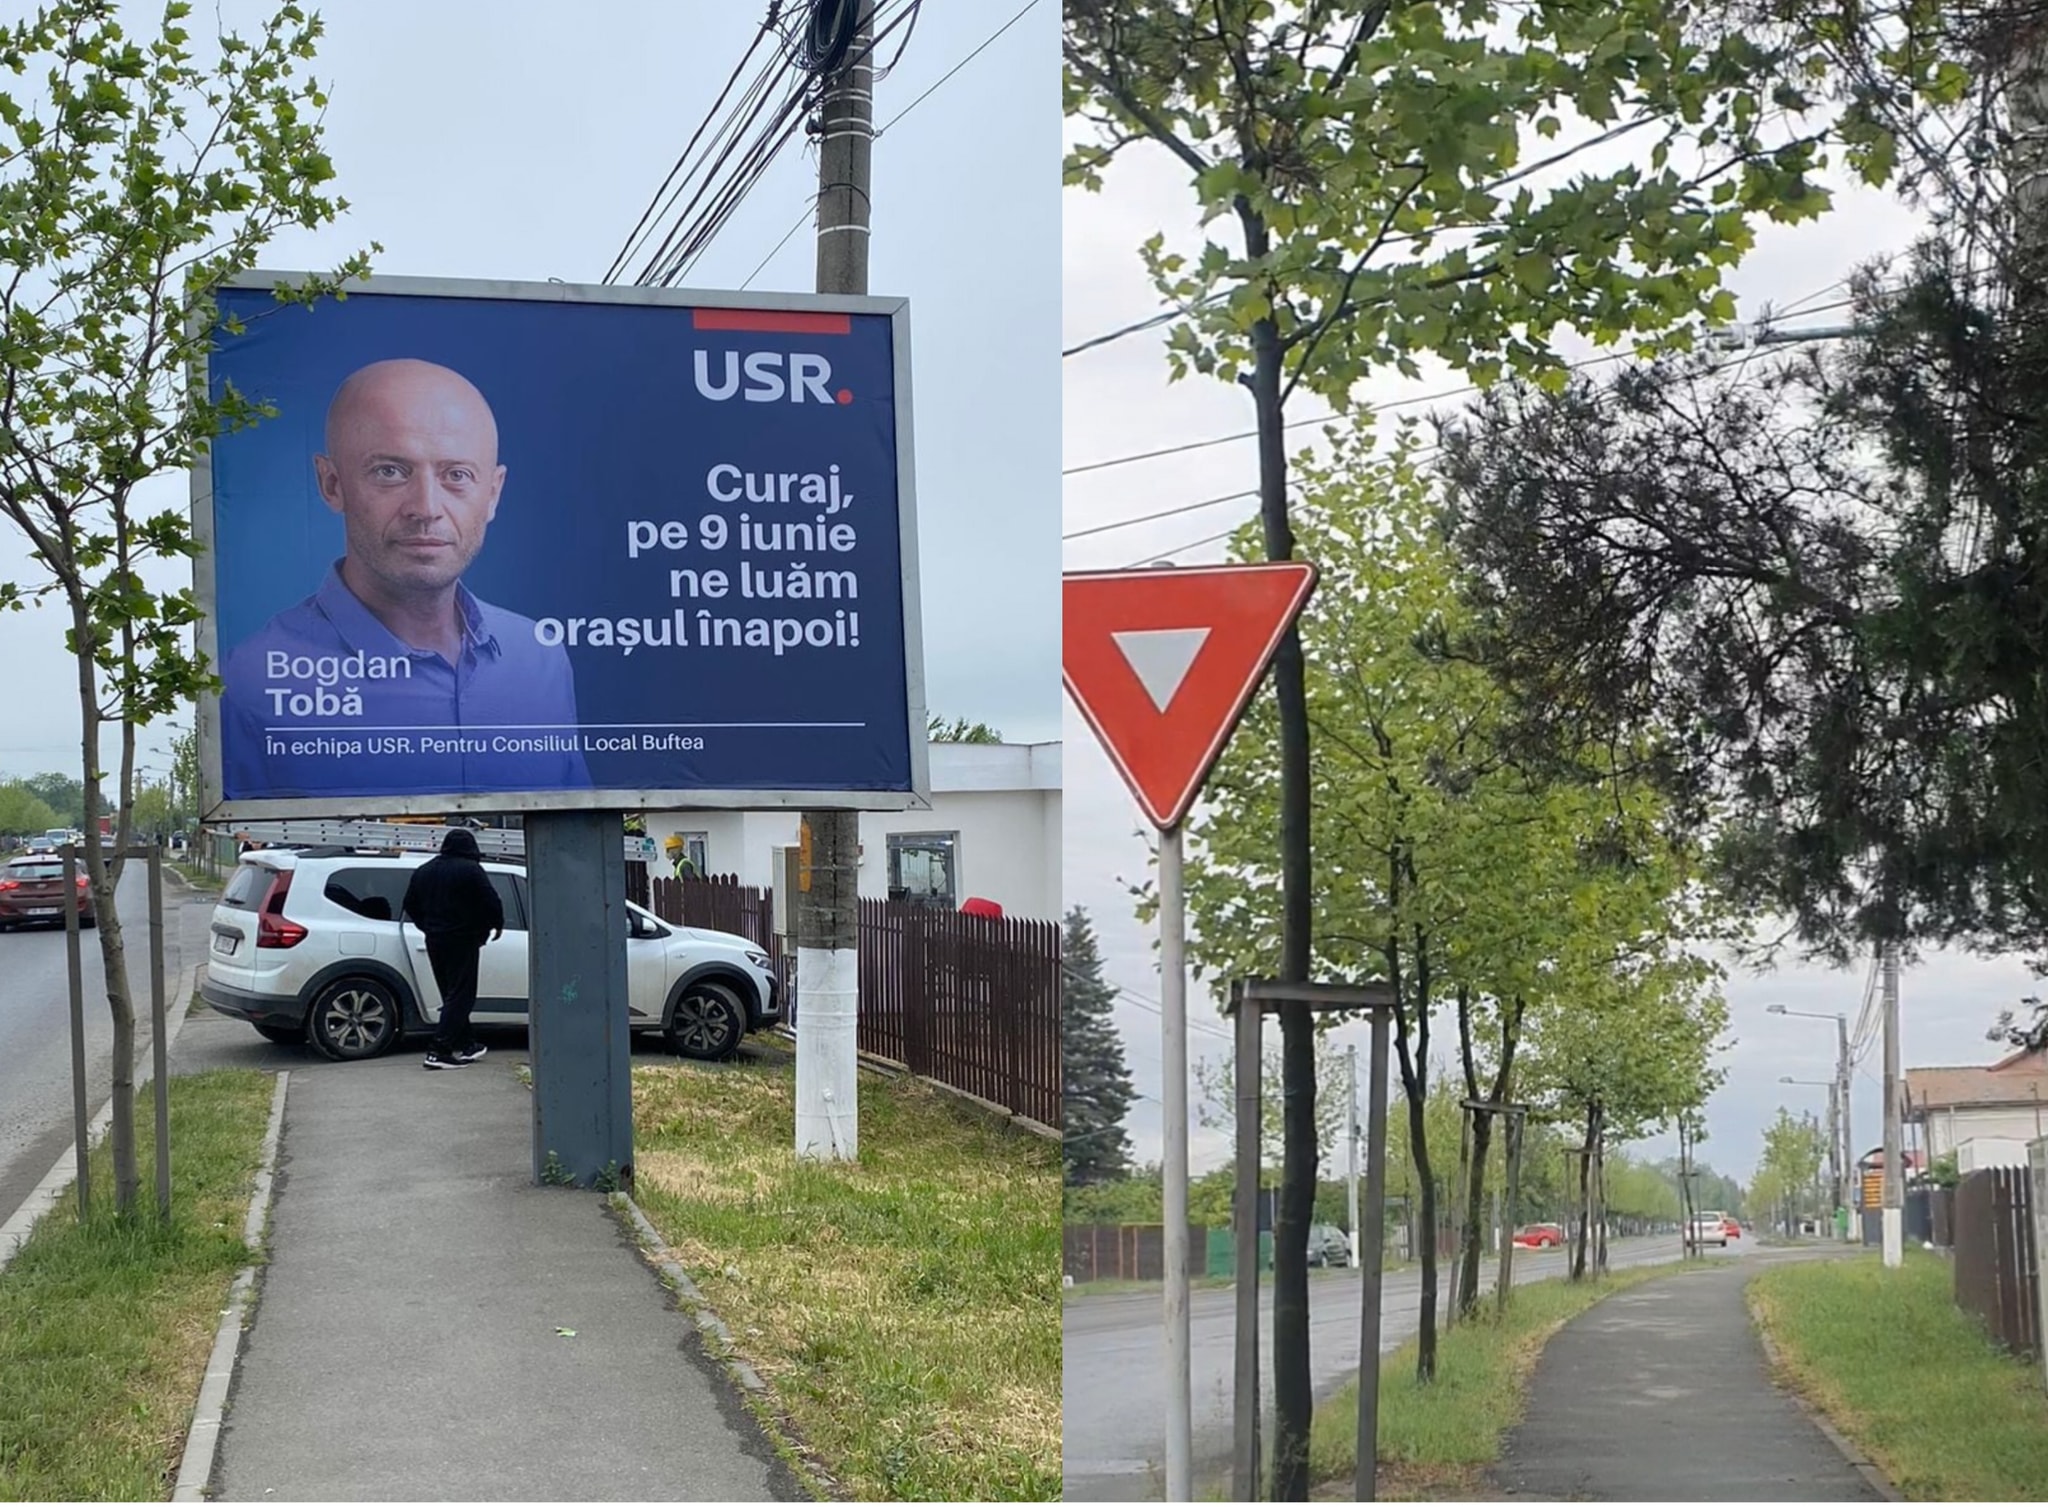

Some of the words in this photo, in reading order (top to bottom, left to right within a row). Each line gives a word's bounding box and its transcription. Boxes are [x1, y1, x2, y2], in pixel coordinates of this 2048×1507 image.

[706, 463, 854, 514] Curaj,
[627, 520, 688, 558] pe
[699, 513, 728, 551] 9
[740, 512, 857, 552] iunie
[670, 569, 729, 598] ne
[740, 561, 858, 599] luăm
[533, 608, 689, 657] orașul
[696, 609, 861, 656] înapoi!
[266, 649, 412, 687] Bogdan
[264, 686, 364, 717] Tobă
[265, 735, 286, 755] În
[290, 738, 362, 758] echipa
[367, 737, 415, 754] USR.
[421, 737, 487, 753] Pentru
[492, 735, 579, 752] Consiliul
[584, 734, 637, 751] Local
[642, 733, 704, 750] Buftea
